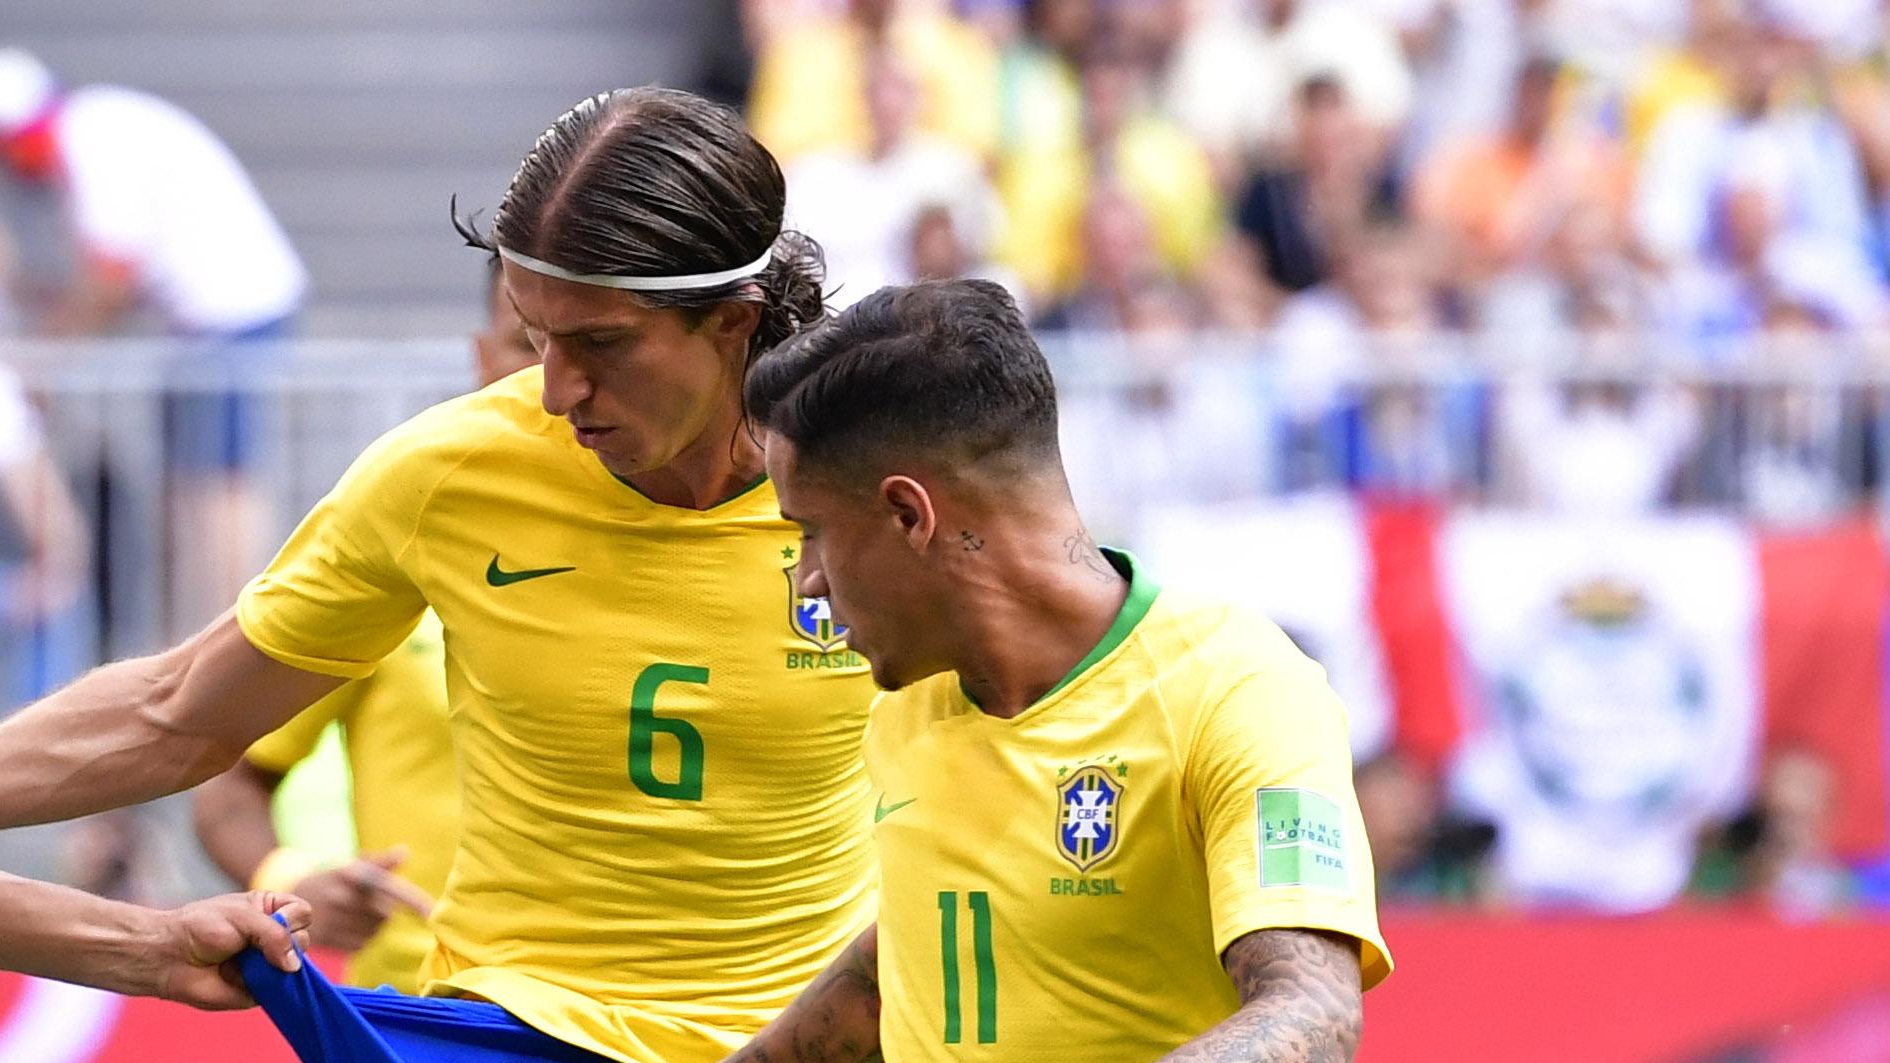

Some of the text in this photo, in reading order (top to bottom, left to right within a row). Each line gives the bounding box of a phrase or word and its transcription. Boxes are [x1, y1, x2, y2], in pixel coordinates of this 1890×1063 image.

[786, 652, 862, 670] BRASIL
[628, 662, 709, 801] 6
[1076, 808, 1100, 820] CBF
[1266, 817, 1341, 838] LIVING
[1316, 854, 1343, 870] FIFA
[1050, 877, 1123, 897] BRASIL
[938, 891, 998, 1044] 11
